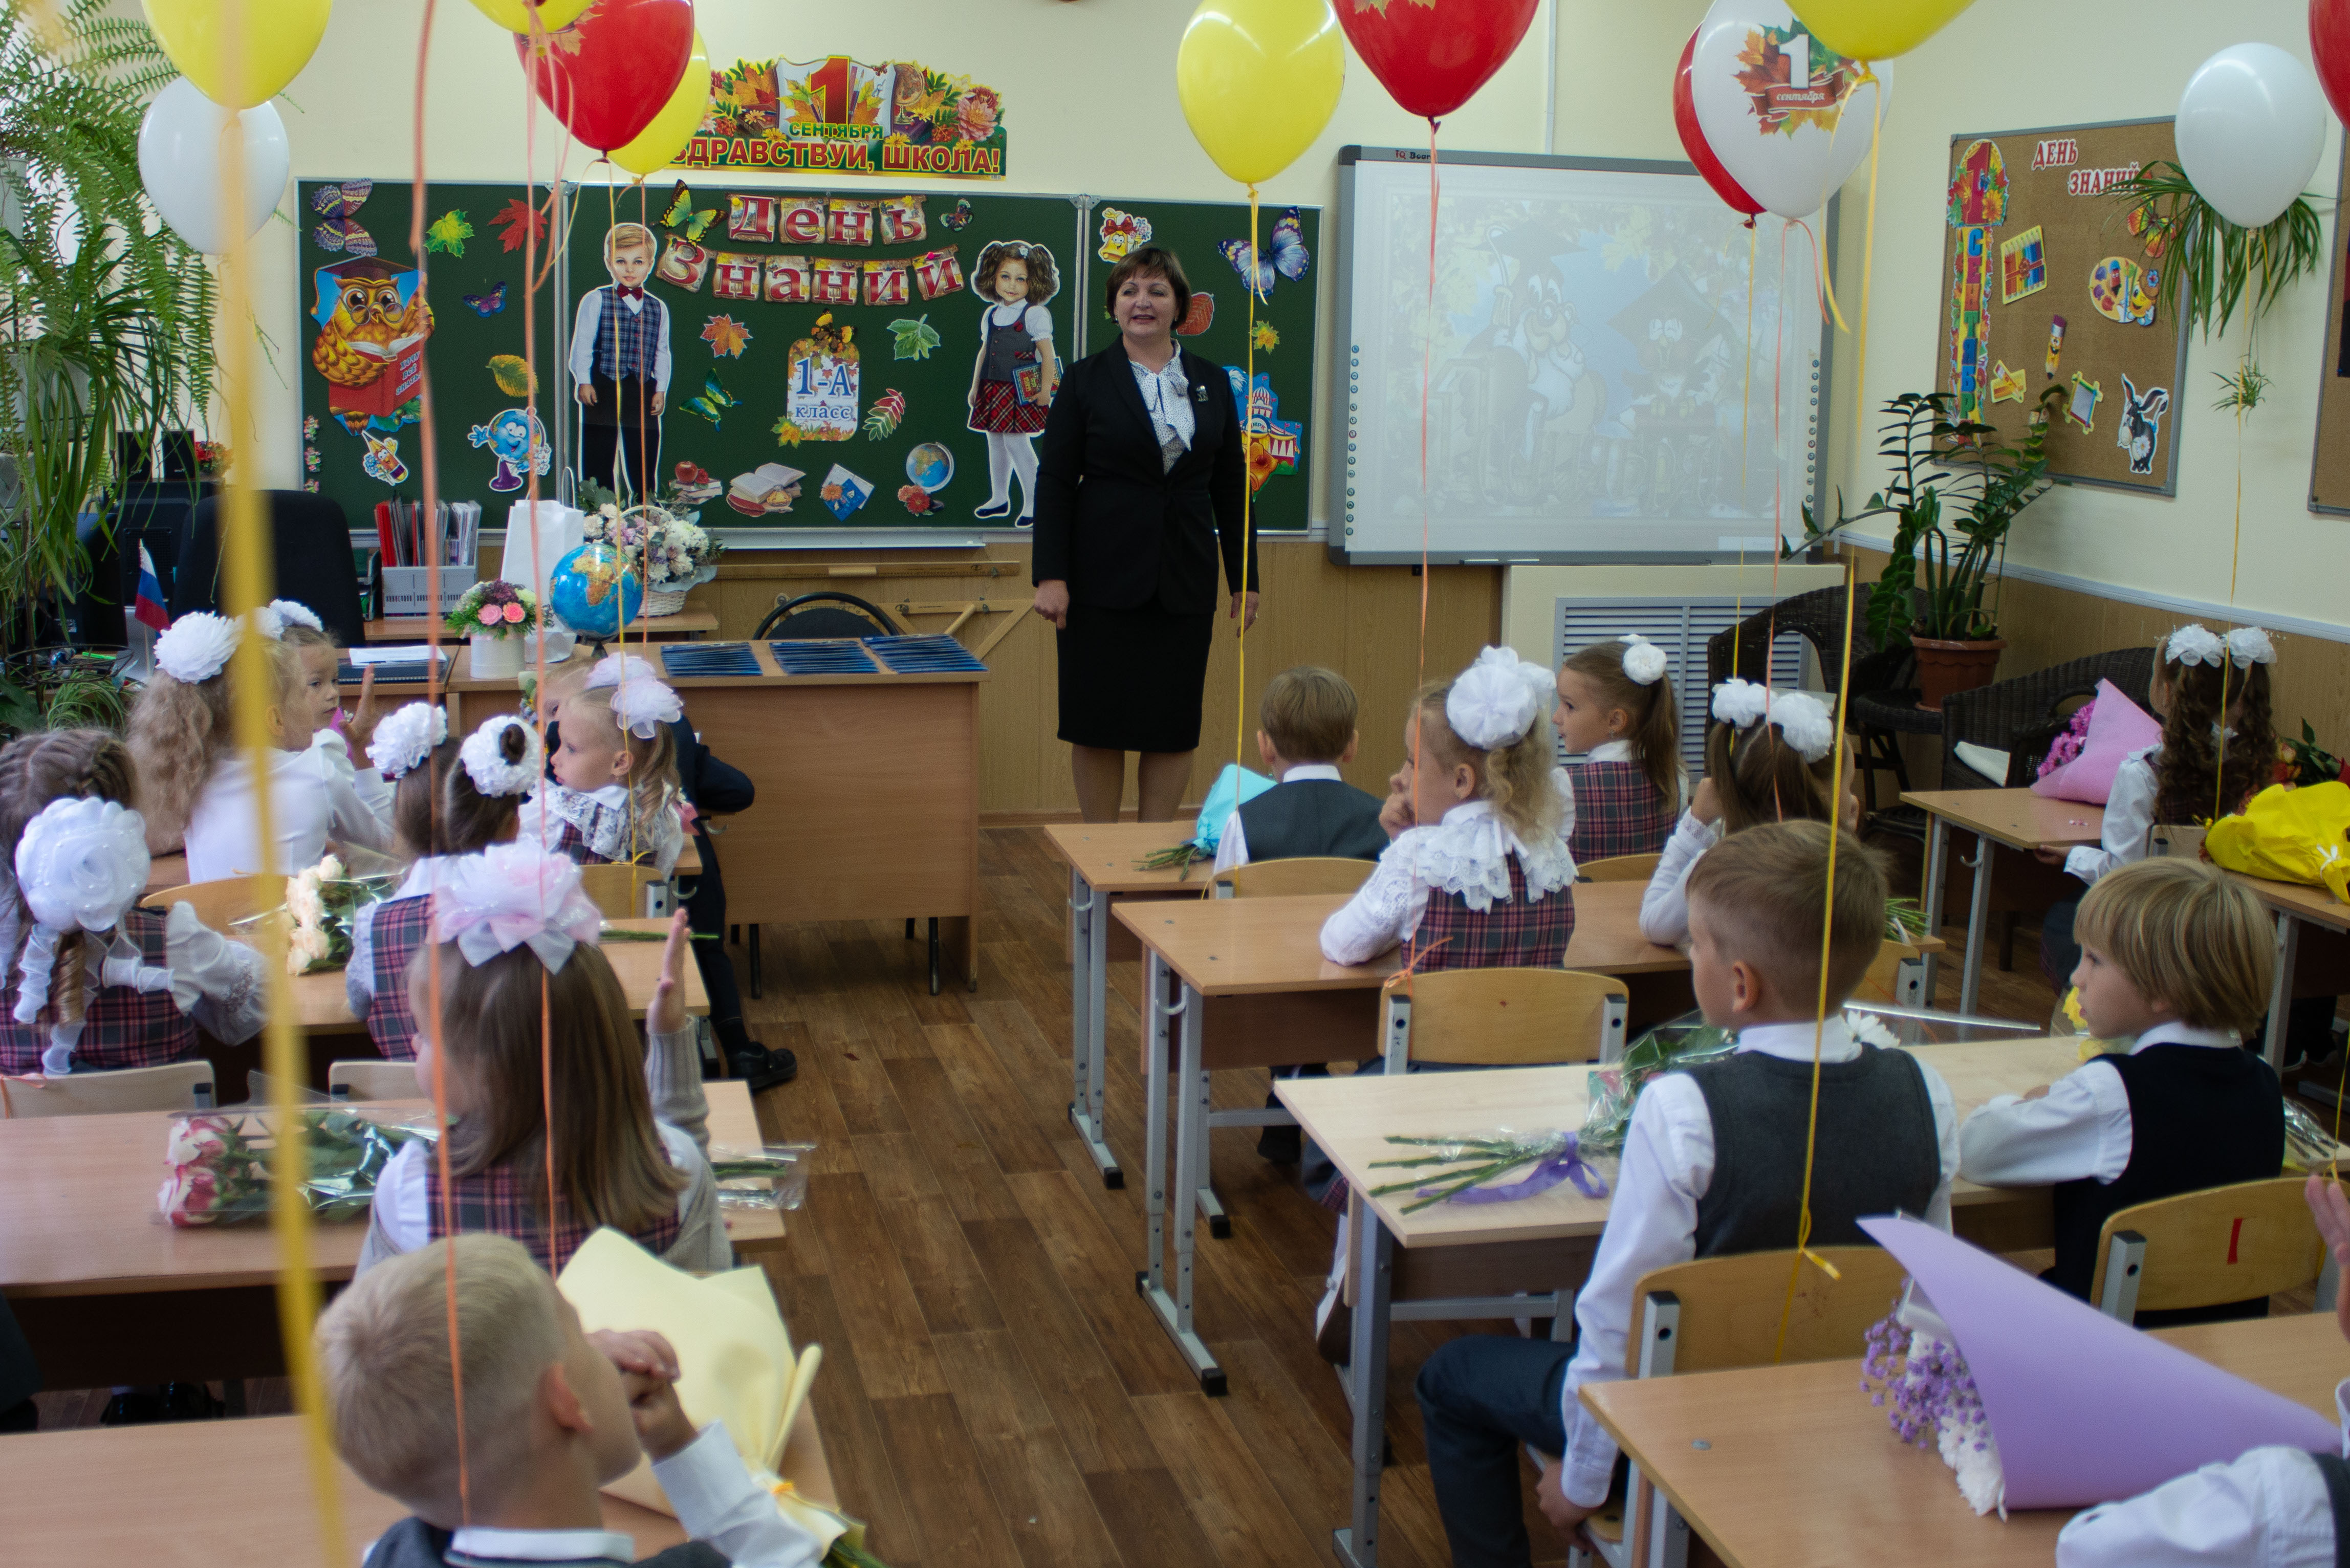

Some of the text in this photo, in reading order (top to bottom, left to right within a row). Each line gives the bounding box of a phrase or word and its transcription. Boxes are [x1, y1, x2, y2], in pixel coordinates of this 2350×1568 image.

[1779, 33, 1809, 89] 1
[810, 56, 849, 124] 1
[1776, 90, 1825, 104] сентября
[788, 121, 884, 140] СЕНТЯБРЯ
[882, 144, 1000, 173] ШКОЛА!
[1410, 151, 1432, 160] Boar
[2032, 140, 2078, 170] ДЕНЬ
[1962, 142, 1992, 224] 1
[730, 195, 923, 244] День
[661, 238, 963, 303] Знаний
[795, 406, 850, 420] класс
